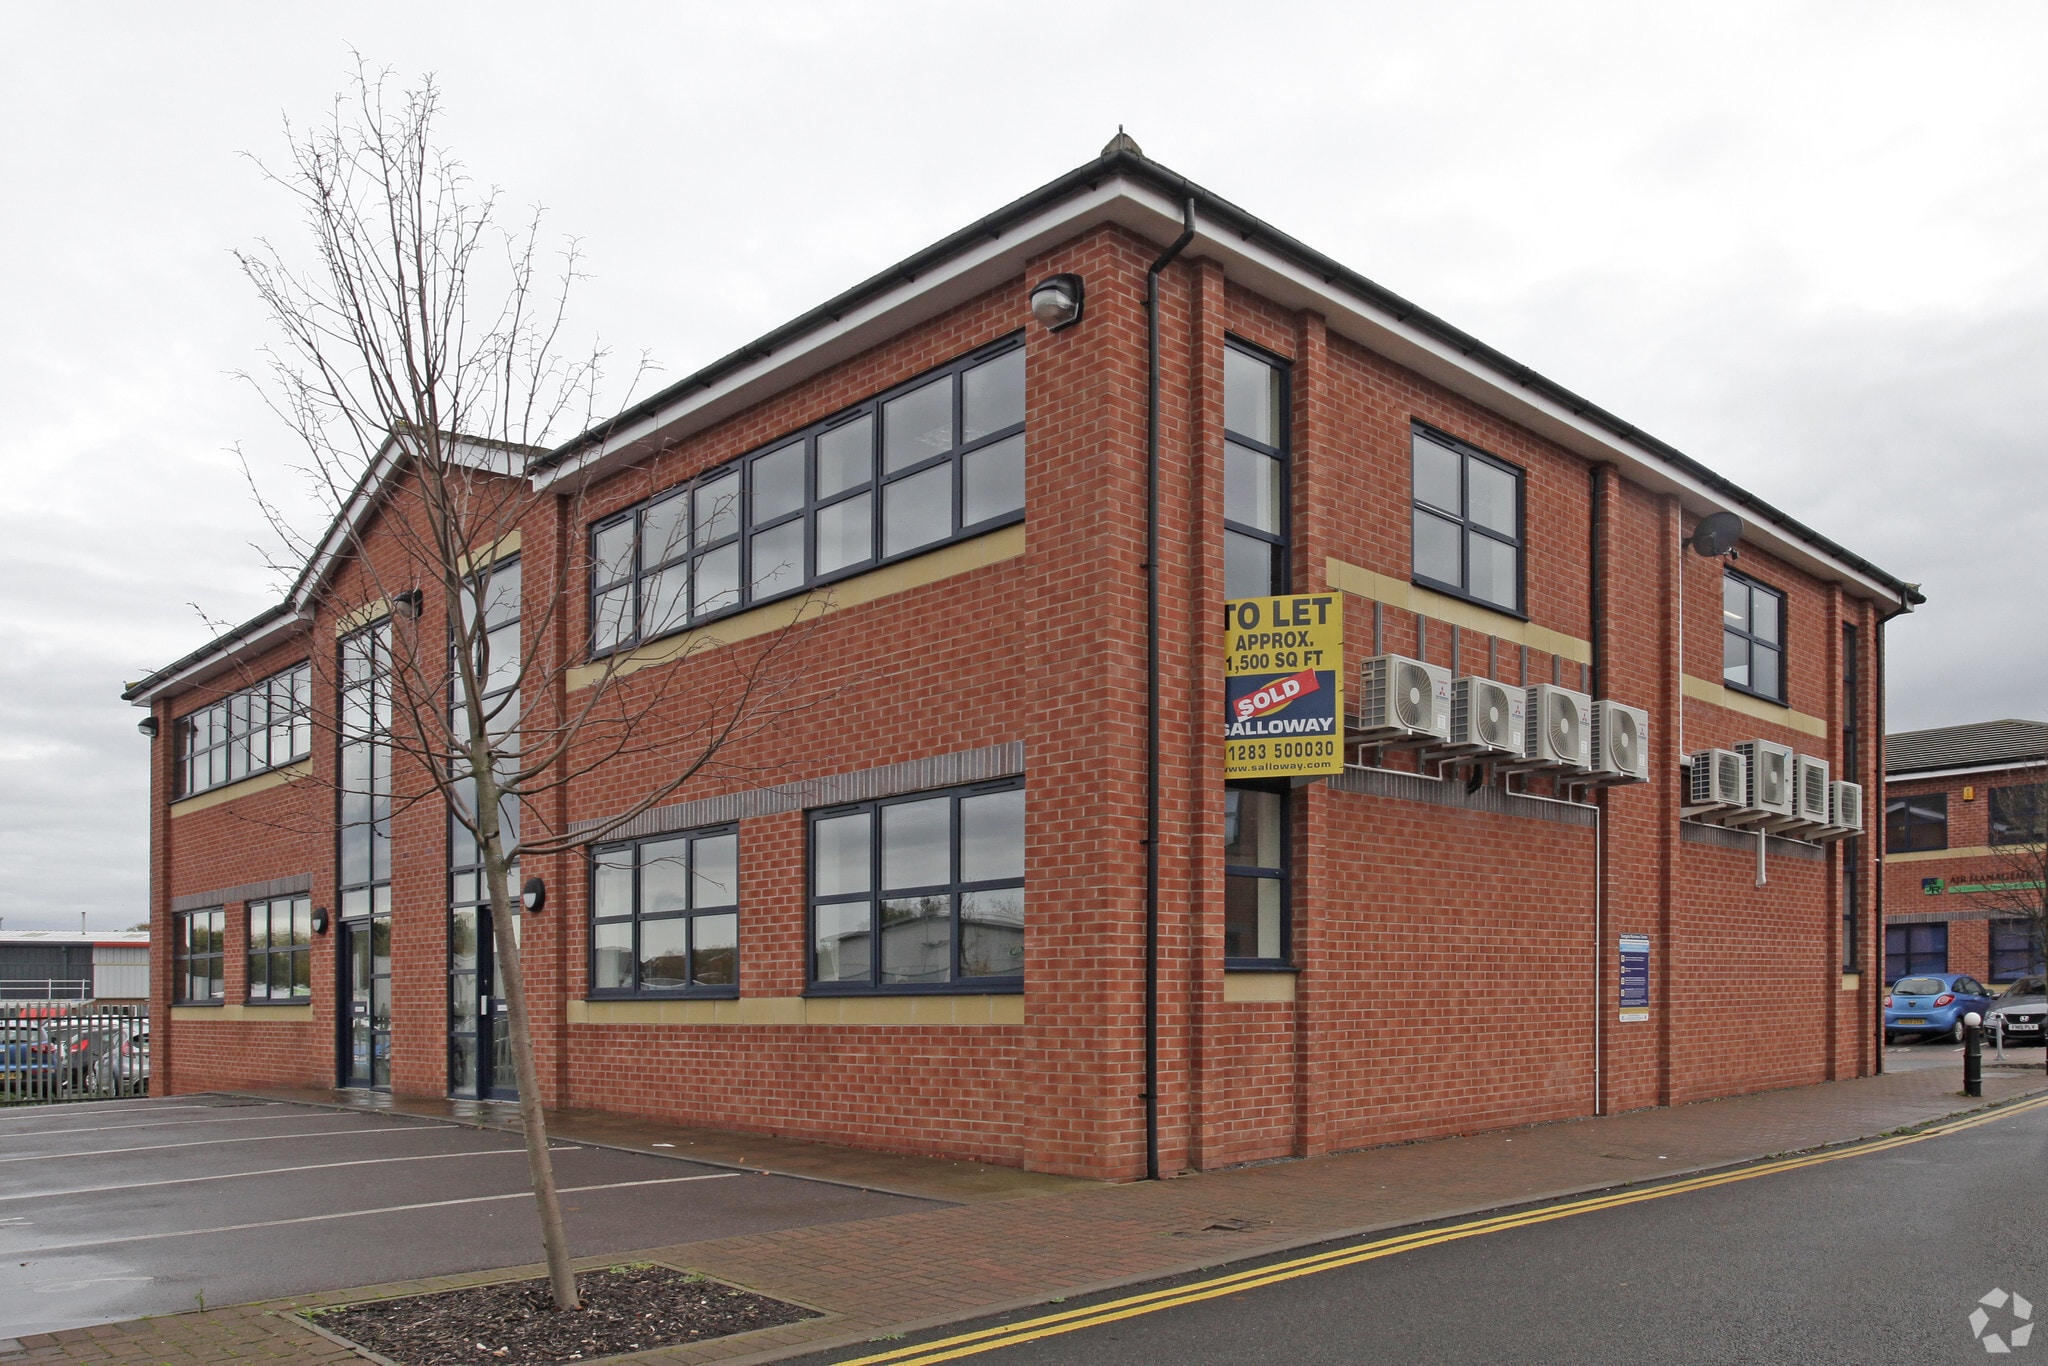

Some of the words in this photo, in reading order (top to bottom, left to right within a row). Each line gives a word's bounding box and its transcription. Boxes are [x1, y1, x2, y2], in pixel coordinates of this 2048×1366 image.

[1273, 597, 1332, 627] LET
[1235, 630, 1314, 652] APPROX.
[1225, 653, 1270, 674] 1,500
[1274, 651, 1298, 668] SQ
[1303, 650, 1323, 667] FT
[1238, 679, 1300, 716] SOLD
[1225, 743, 1266, 761] 1283
[1274, 740, 1334, 758] 500030
